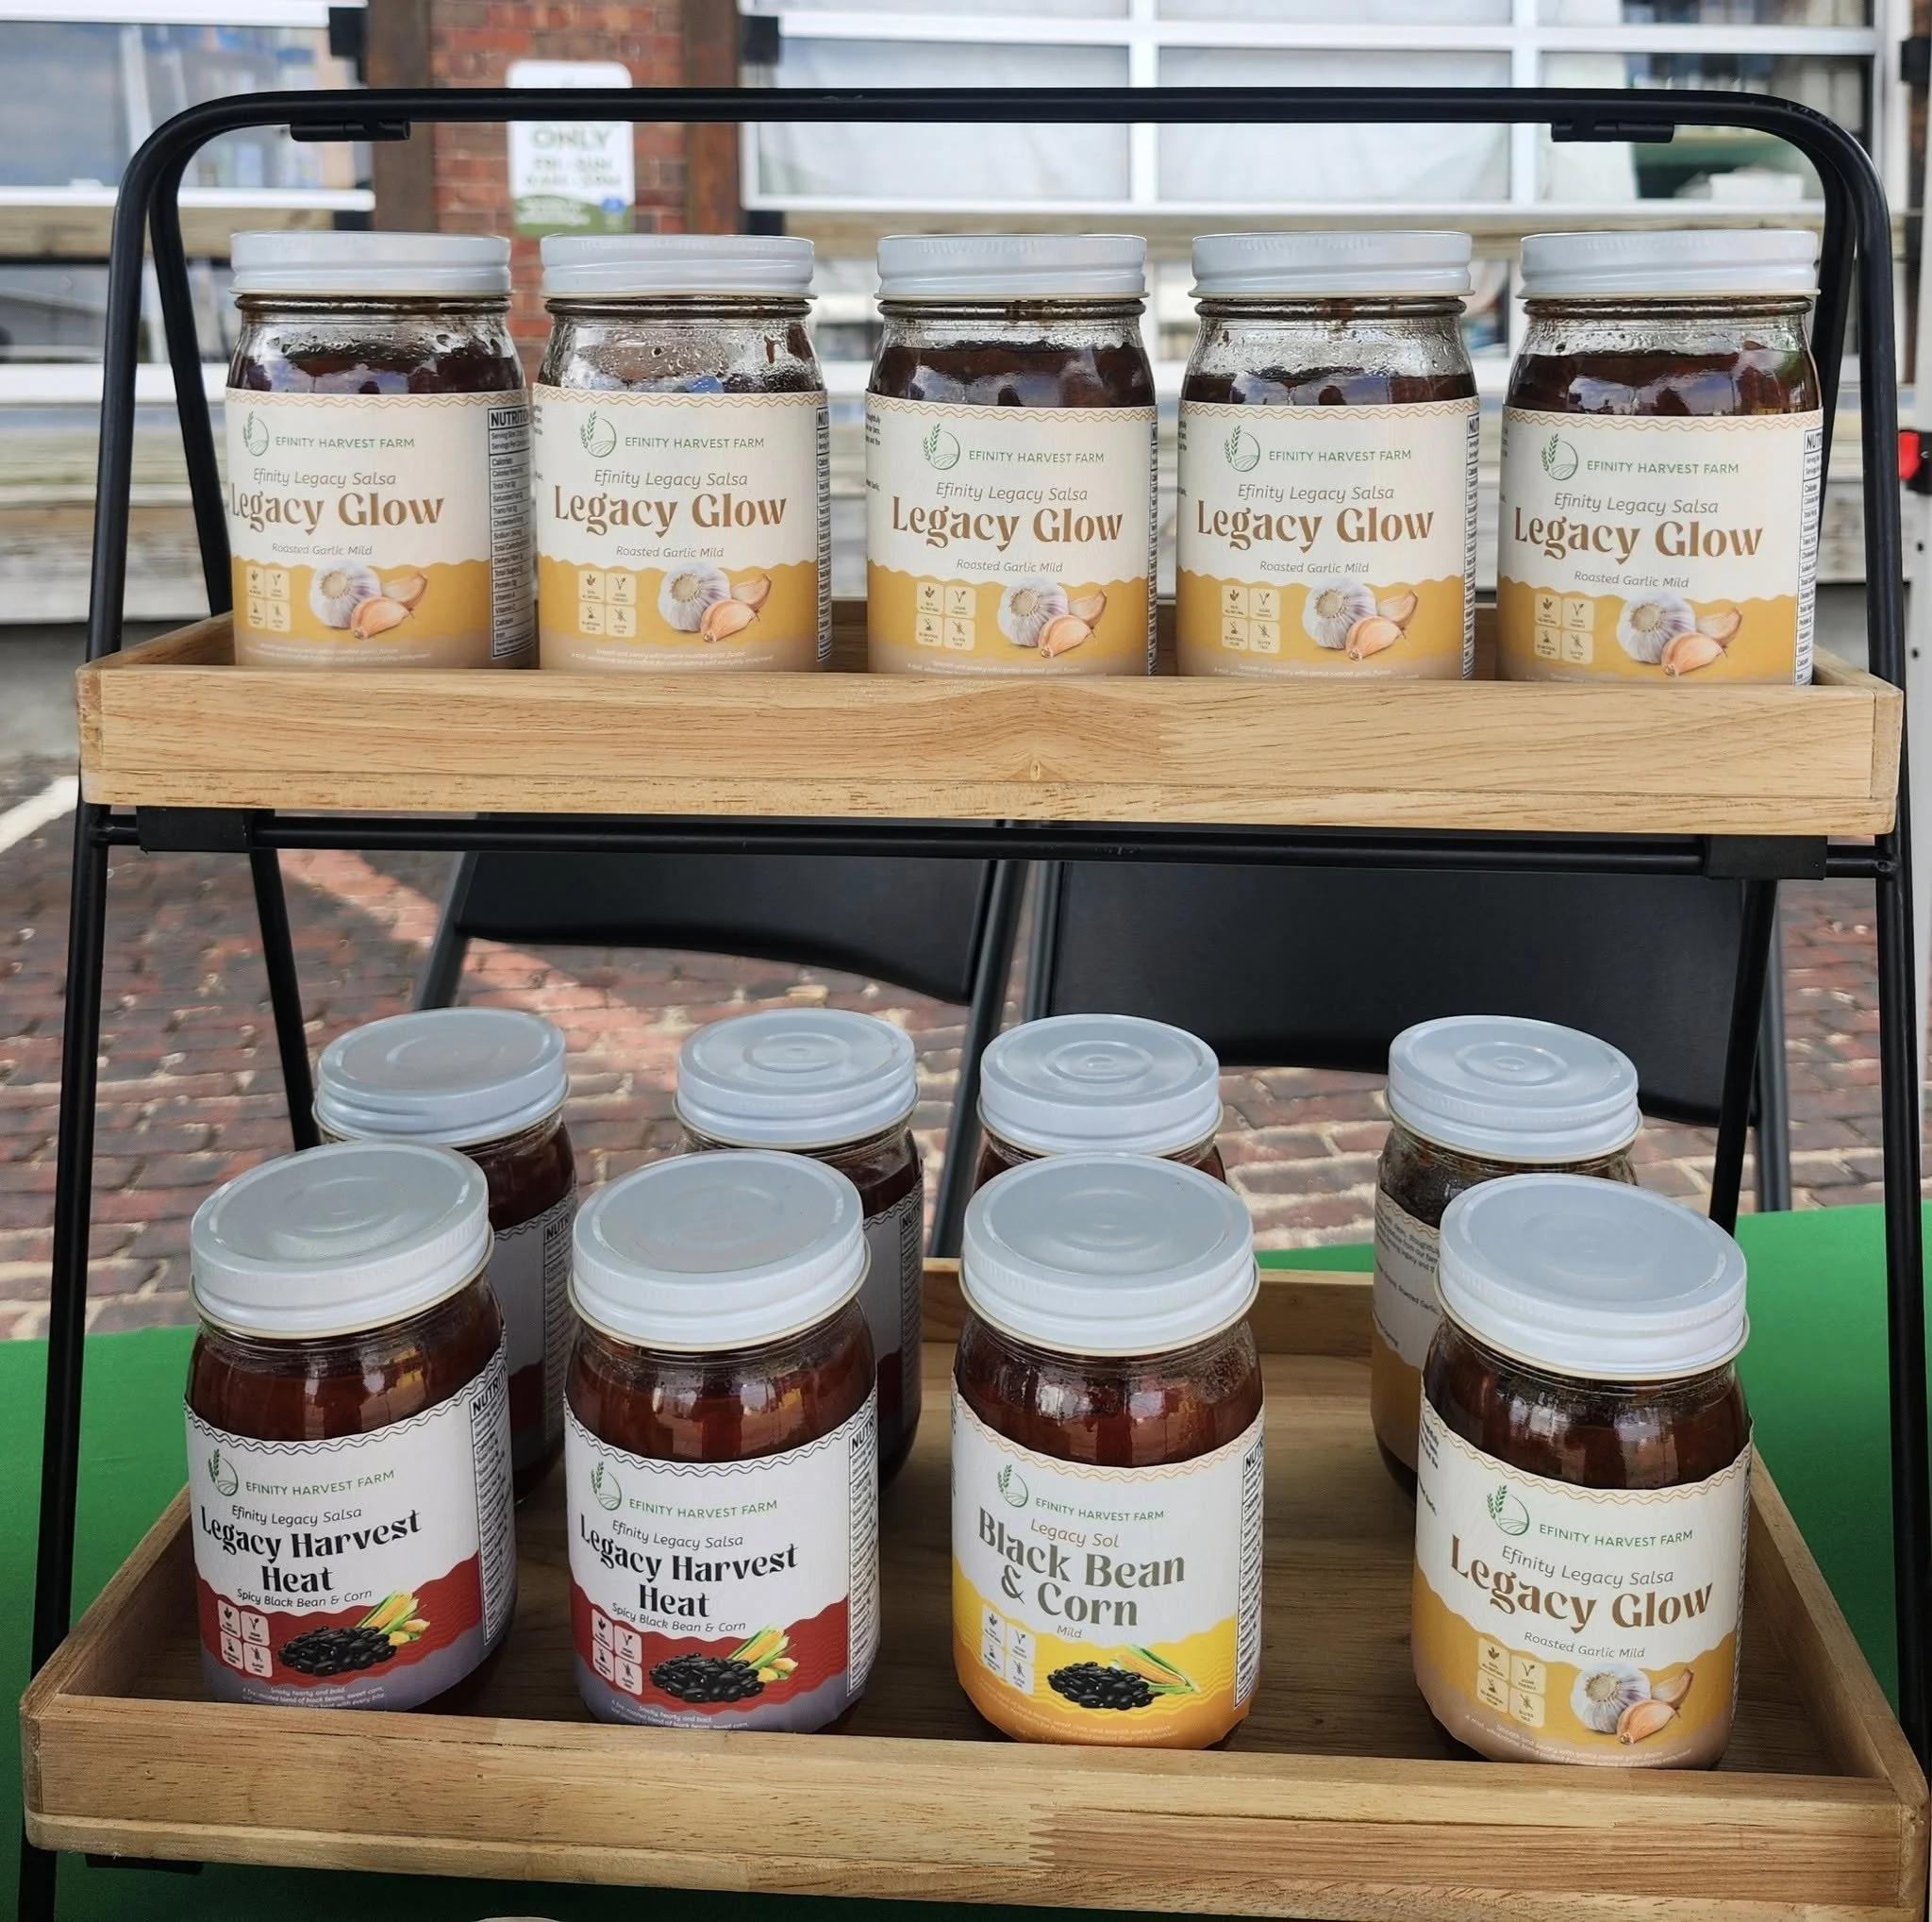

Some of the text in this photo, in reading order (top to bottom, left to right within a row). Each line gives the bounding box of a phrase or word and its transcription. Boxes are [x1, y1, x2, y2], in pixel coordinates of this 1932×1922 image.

[276, 437, 414, 448] EFINITY HARVEST FARM
[625, 437, 764, 448] EFINITY HARVEST FARM
[969, 450, 1104, 462] EFINITY HARVEST FARM
[1269, 450, 1411, 462] EFINITY HARVEST FARM
[1588, 460, 1739, 475] EFINITY HARVEST FARM
[254, 468, 396, 488] Efinity Legacy Salsa
[594, 469, 748, 489] Efinity Legacy Salsa
[936, 482, 1088, 504] Efinity Legacy Salsa
[1238, 485, 1393, 504] Efinity Legacy Salsa
[1554, 493, 1719, 516] Efinity Legacy Salsa
[231, 483, 325, 535] Legacy
[339, 493, 444, 526] Glow
[555, 485, 678, 537] Legacy
[692, 493, 787, 527] Glow
[892, 496, 1124, 552] Legacy Glow
[1197, 501, 1434, 553] Legacy Glow
[1514, 507, 1763, 565] Legacy Glow
[272, 543, 373, 556] Roasted Garlic Mild
[616, 546, 724, 558] Roasted Garlic Mild
[957, 560, 1063, 573] Roasted Garlic Mild
[1260, 561, 1369, 574] Roasted Garlic Mild
[1574, 570, 1689, 588] Roasted Garlic Mild
[246, 1470, 394, 1496] EFINITY HARVEST FARM
[232, 1506, 362, 1528] Efinity Legacy Salsa
[629, 1498, 777, 1518] EFINITY HARVEST FARM
[1036, 1498, 1164, 1521] EFINITY HARVEST FARM
[200, 1505, 423, 1564] Legacy Harvest
[612, 1520, 743, 1550] Efinity Legacy Salsa
[1030, 1519, 1120, 1548] Legacy Sol
[1540, 1524, 1692, 1547] EFINITY HARVEST FARM
[580, 1513, 798, 1583] Legacy Harvest
[979, 1507, 1185, 1589] Black Bean
[1502, 1546, 1674, 1587] Efinity Legacy Salsa
[261, 1564, 334, 1593] Heat
[1451, 1534, 1713, 1634] Legacy Glow
[237, 1589, 372, 1608] Spicy Black Bean & Corn
[639, 1584, 709, 1617] Heat
[1001, 1564, 1138, 1627] & Corn
[612, 1603, 746, 1631] Spicy Black Bean & Corn
[1057, 1625, 1082, 1638] Mild
[1524, 1631, 1645, 1659] Roasted Garlic Mild
